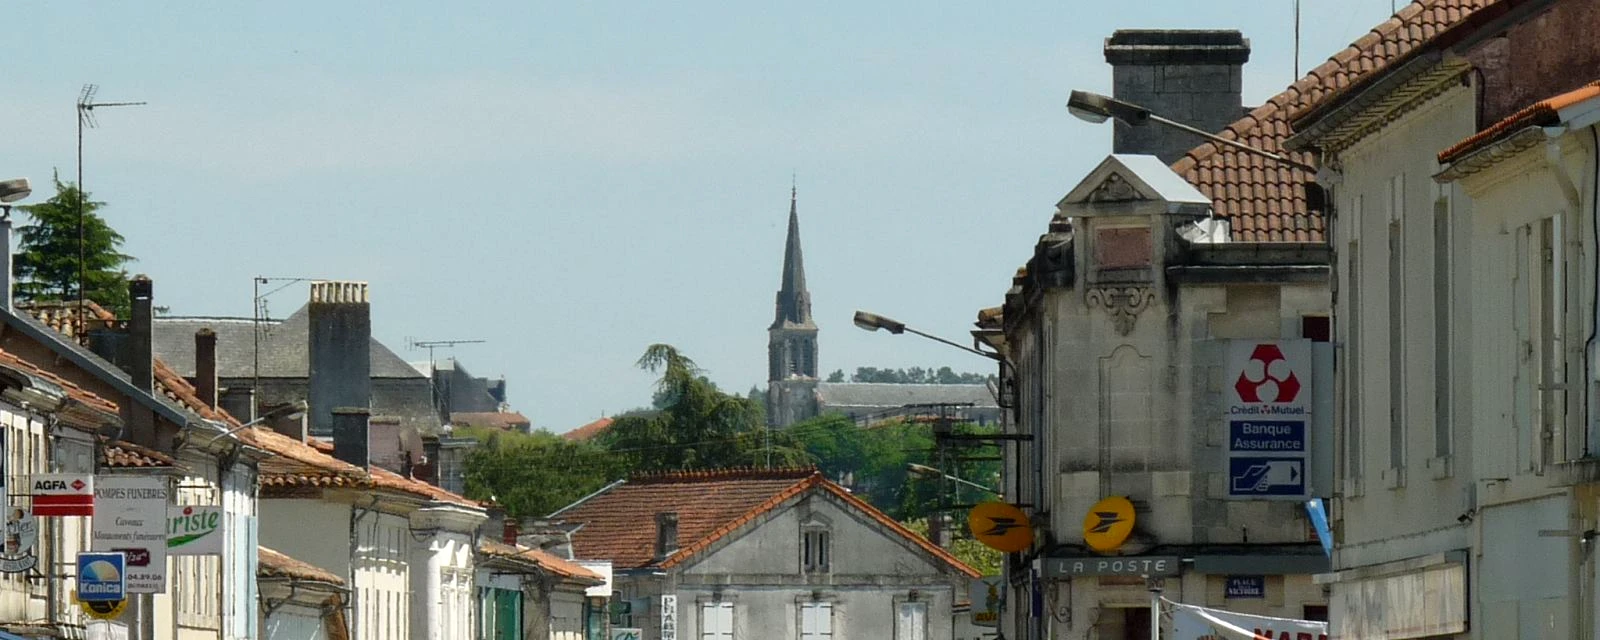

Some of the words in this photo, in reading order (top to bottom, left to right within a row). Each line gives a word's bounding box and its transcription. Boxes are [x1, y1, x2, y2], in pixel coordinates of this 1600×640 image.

[1271, 405, 1304, 415] Mutuel
[1243, 423, 1291, 436] Banque
[1234, 438, 1300, 449] Assurance
[35, 480, 67, 491] AGFA
[94, 488, 125, 499] POMPES
[1060, 562, 1084, 573] LA
[1098, 560, 1166, 573] POSTE
[80, 582, 121, 594] Konica
